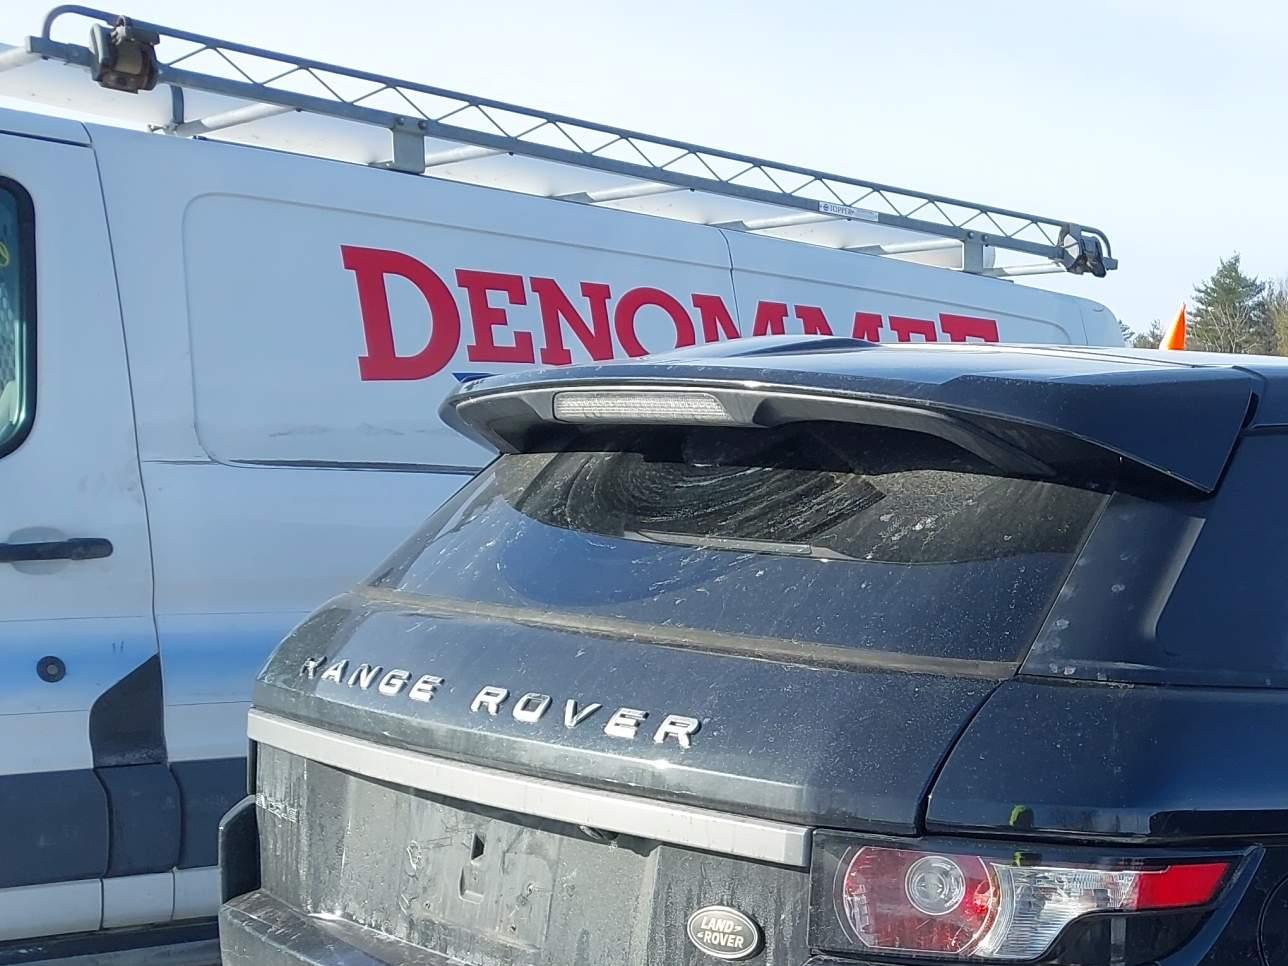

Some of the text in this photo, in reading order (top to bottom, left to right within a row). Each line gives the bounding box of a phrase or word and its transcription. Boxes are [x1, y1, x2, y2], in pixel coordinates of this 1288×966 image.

[299, 655, 702, 748] RANGE ROVER
[700, 917, 735, 932] LAND
[703, 930, 745, 948] ROVER
